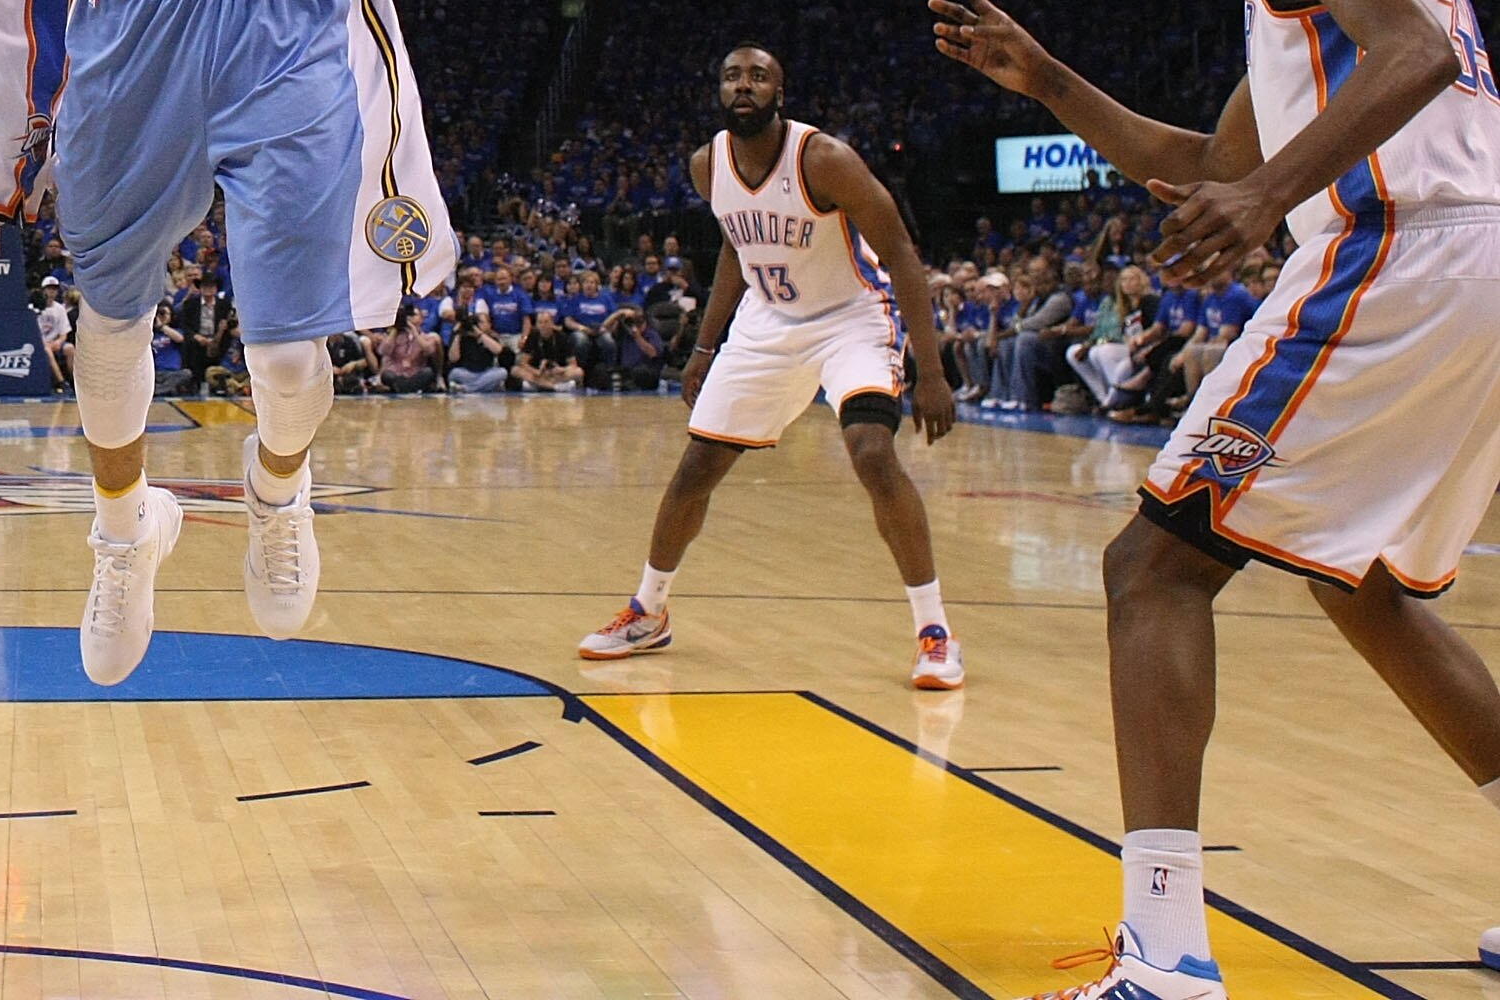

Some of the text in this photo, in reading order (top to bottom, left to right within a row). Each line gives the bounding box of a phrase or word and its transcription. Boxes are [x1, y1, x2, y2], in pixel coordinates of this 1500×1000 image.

[720, 209, 816, 250] HUNDER
[748, 263, 801, 305] 13
[1192, 433, 1260, 458] OKC
